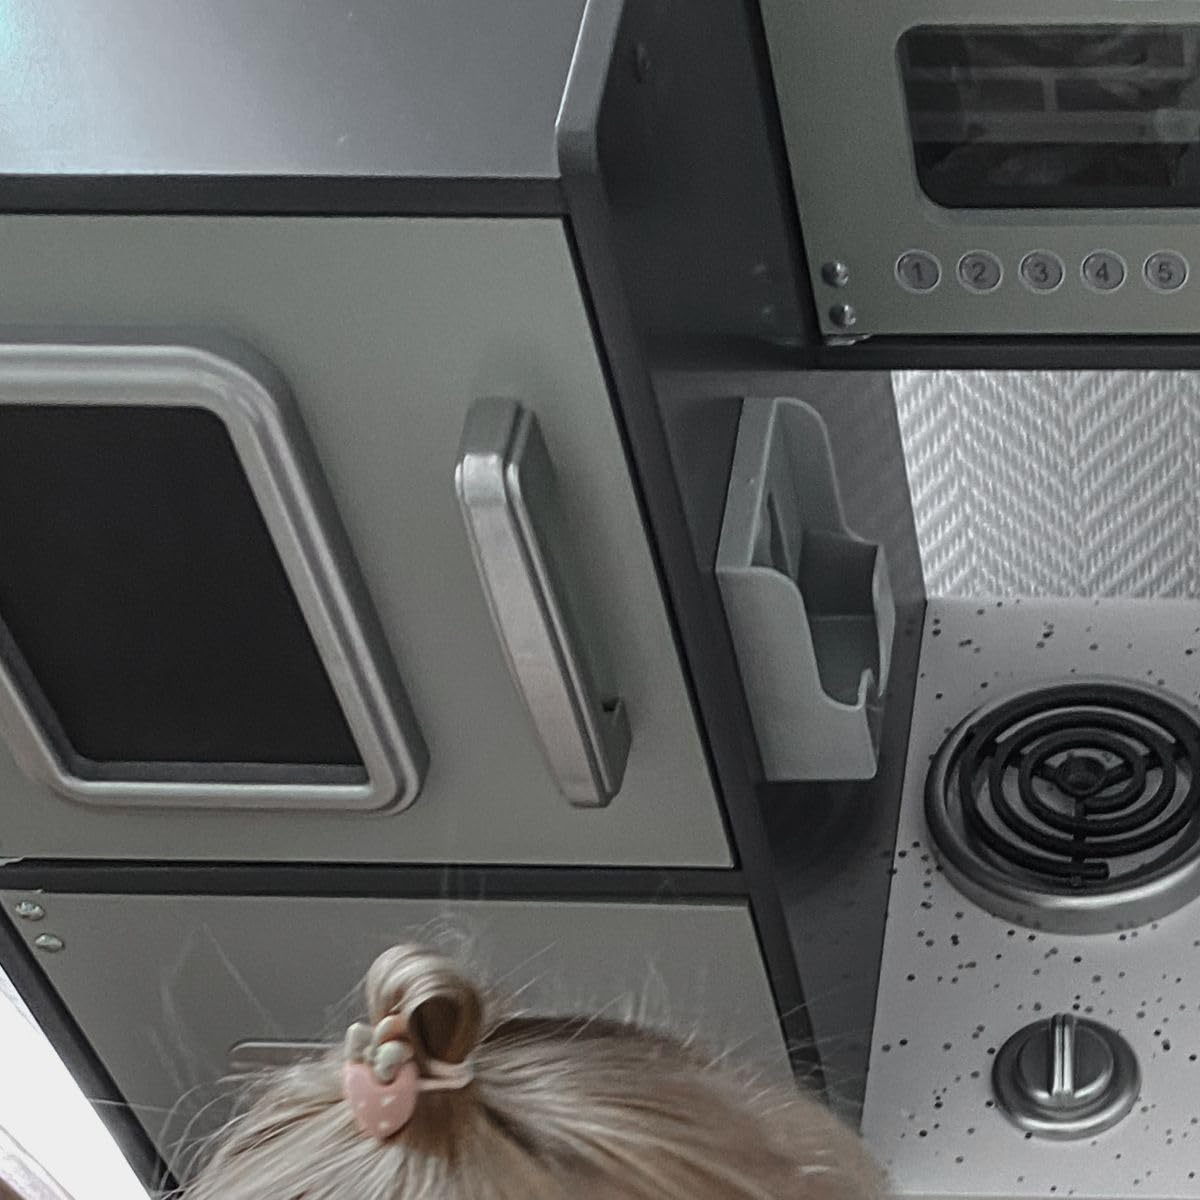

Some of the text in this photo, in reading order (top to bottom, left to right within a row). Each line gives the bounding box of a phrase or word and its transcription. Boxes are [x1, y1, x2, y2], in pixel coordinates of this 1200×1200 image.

[911, 262, 924, 282] 1
[971, 262, 986, 283] 2
[1033, 262, 1048, 282] 3
[1096, 262, 1109, 282] 4
[1158, 262, 1172, 282] 5
